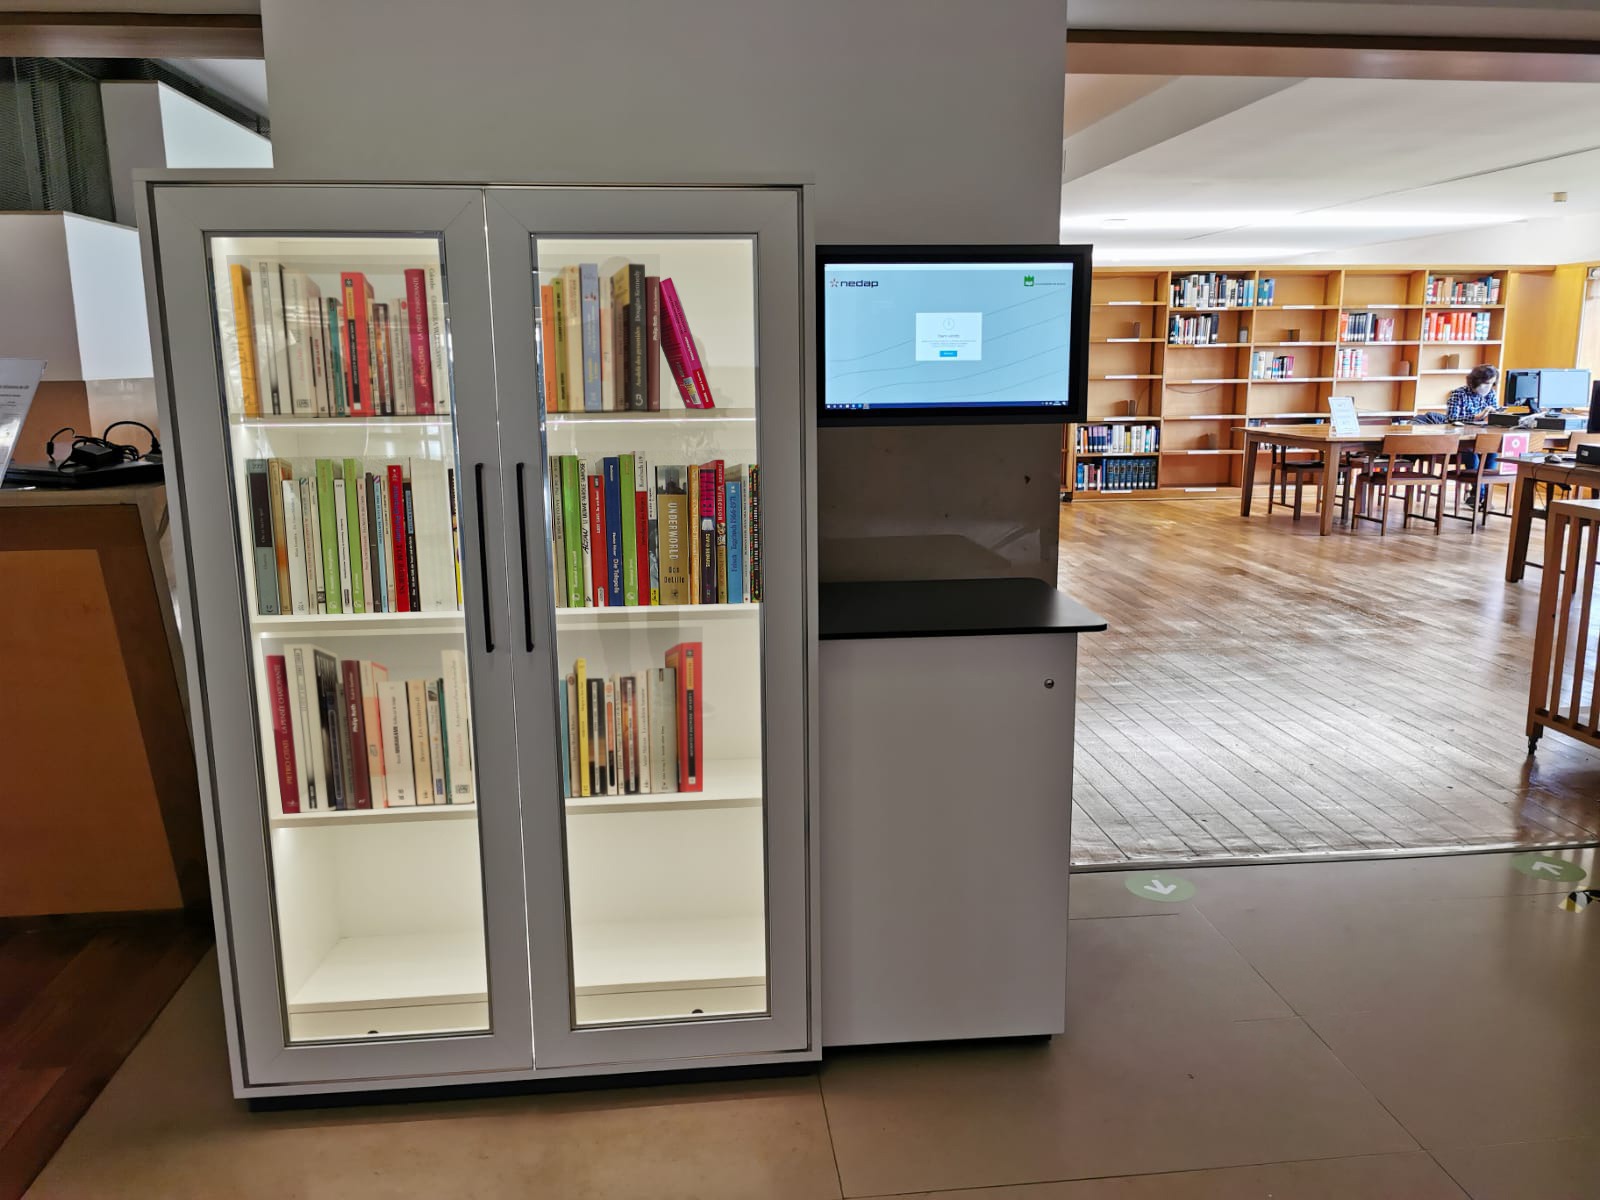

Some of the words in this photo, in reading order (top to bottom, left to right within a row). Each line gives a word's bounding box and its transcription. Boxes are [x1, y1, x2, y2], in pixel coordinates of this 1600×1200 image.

[840, 279, 879, 288] nedap
[700, 471, 715, 516] NAKED
[717, 484, 725, 520] Winterson
[667, 501, 679, 561] UNDERWORLD
[612, 569, 620, 593] Telepolis
[663, 575, 685, 584] DeLillo
[349, 703, 357, 716] Roth
[280, 725, 287, 734] LA
[350, 717, 359, 732] Philip
[281, 739, 290, 760] CITATI
[283, 760, 292, 784] PIETRO
